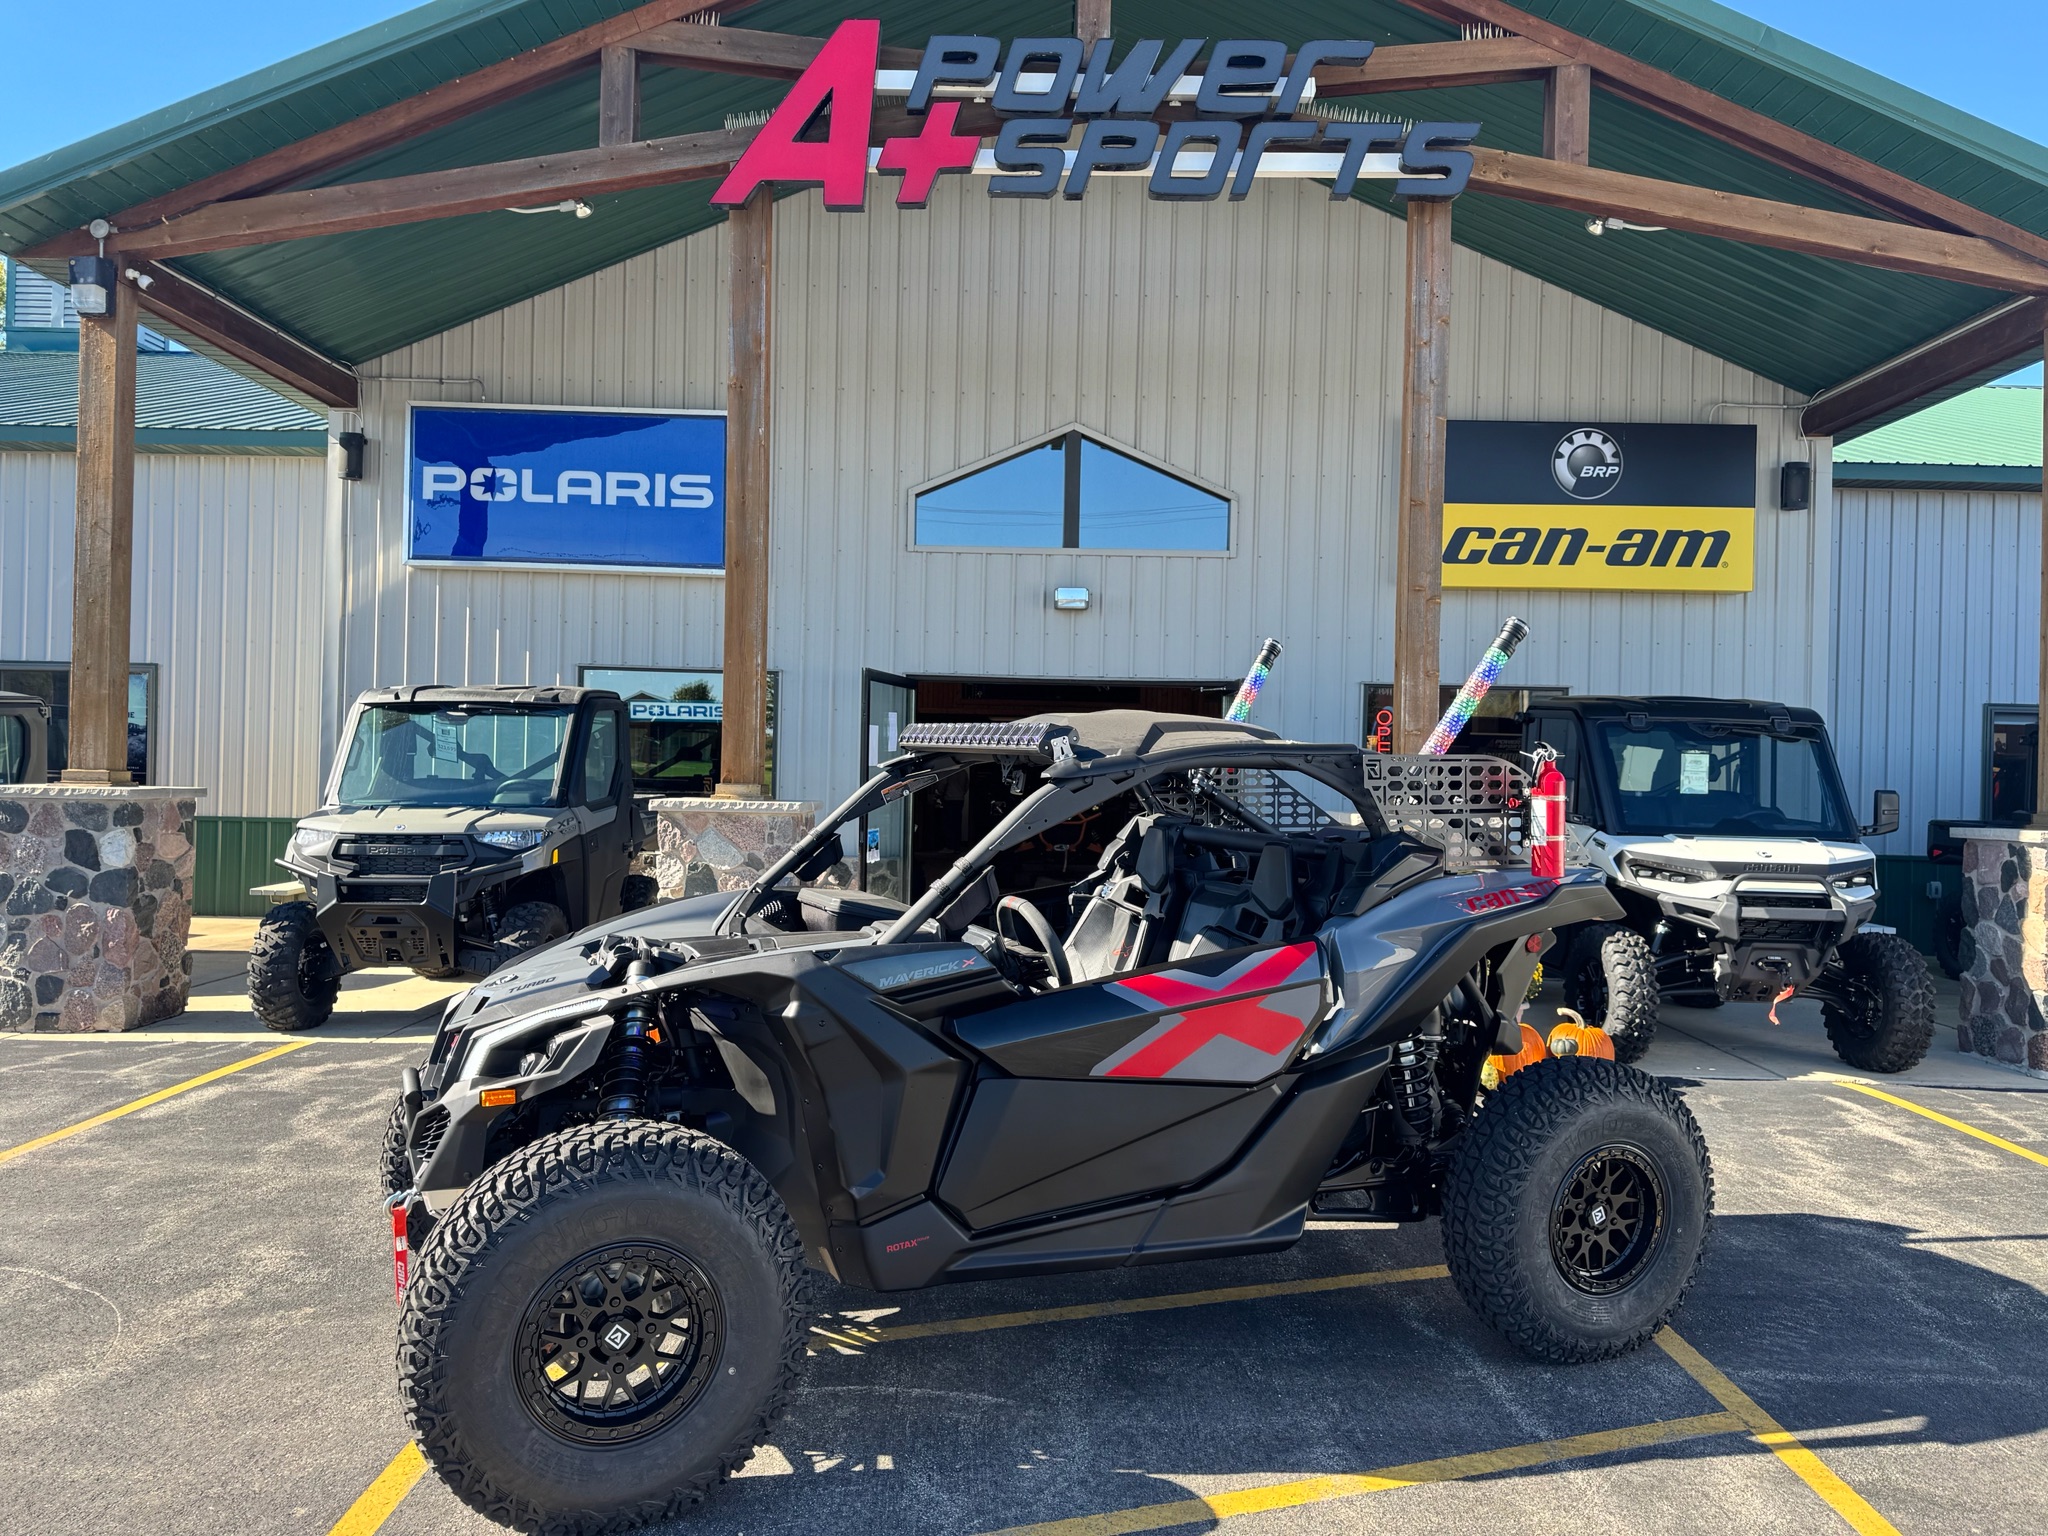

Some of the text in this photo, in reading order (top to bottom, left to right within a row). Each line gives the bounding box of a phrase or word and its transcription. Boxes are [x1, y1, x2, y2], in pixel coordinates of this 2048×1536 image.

[1579, 465, 1620, 479] BRP
[421, 465, 715, 510] POLARIS
[1441, 526, 1732, 569] can-am
[557, 816, 575, 830] XP
[879, 956, 977, 987] MAVERICK X
[508, 976, 558, 994] TURBO
[886, 1238, 918, 1253] ROTAX
